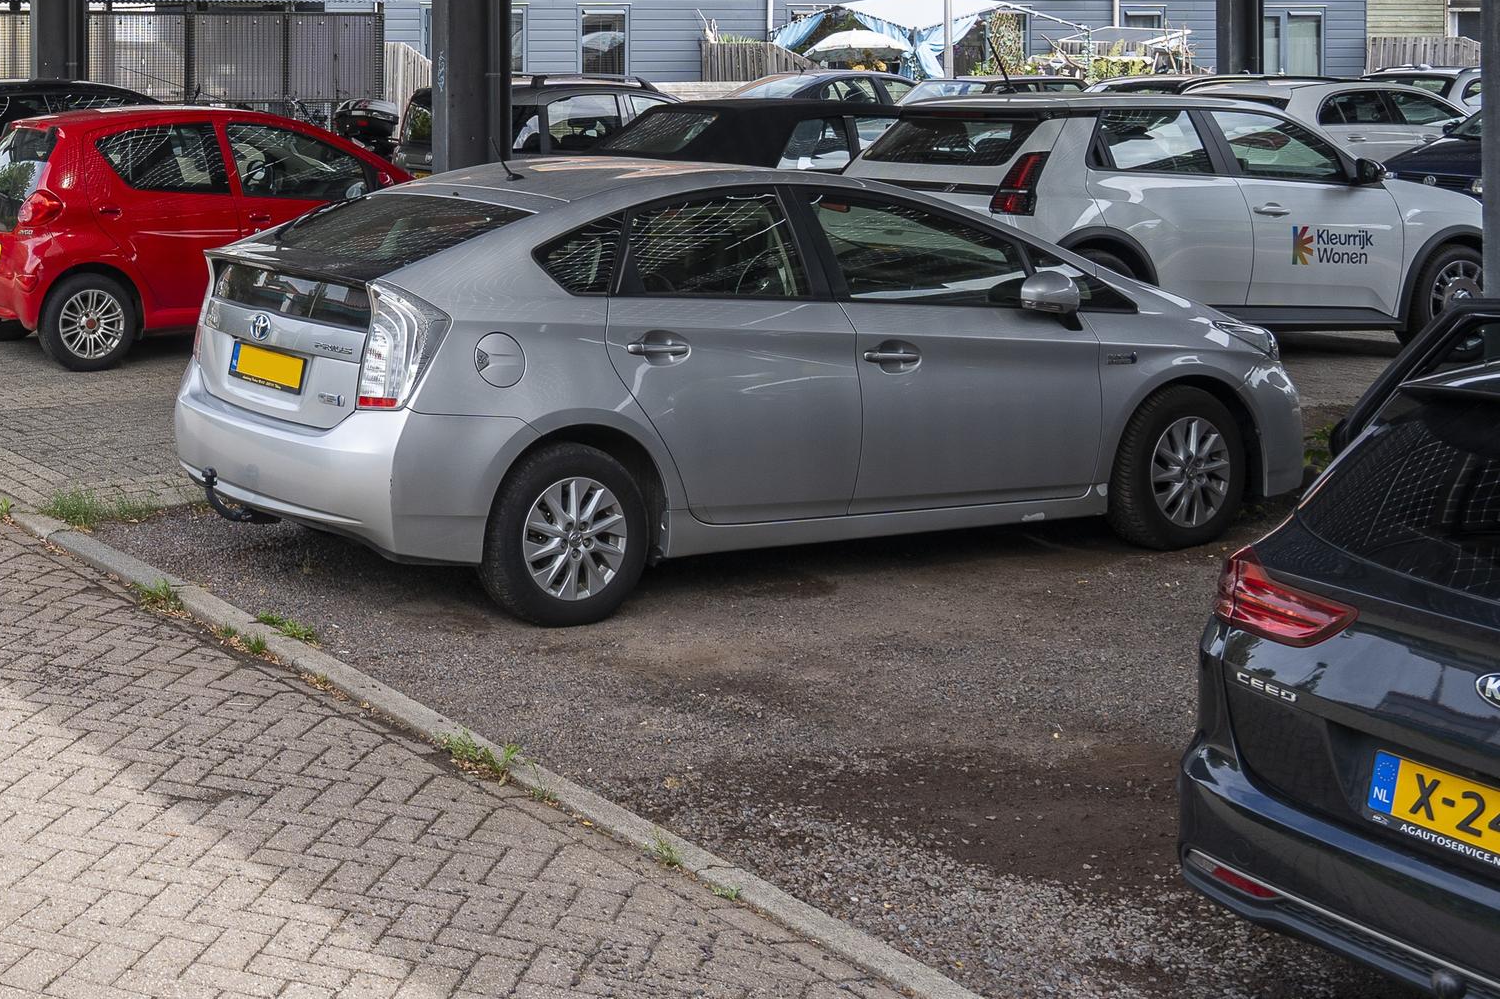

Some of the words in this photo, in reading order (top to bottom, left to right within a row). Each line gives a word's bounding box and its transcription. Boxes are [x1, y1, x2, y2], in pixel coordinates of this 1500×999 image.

[1316, 229, 1374, 250] Kleurrijk
[1317, 247, 1368, 265] Wonen
[1236, 671, 1299, 703] CEED
[1373, 786, 1390, 804] NL
[1399, 823, 1500, 867] AGAUTOSERVICE.N
